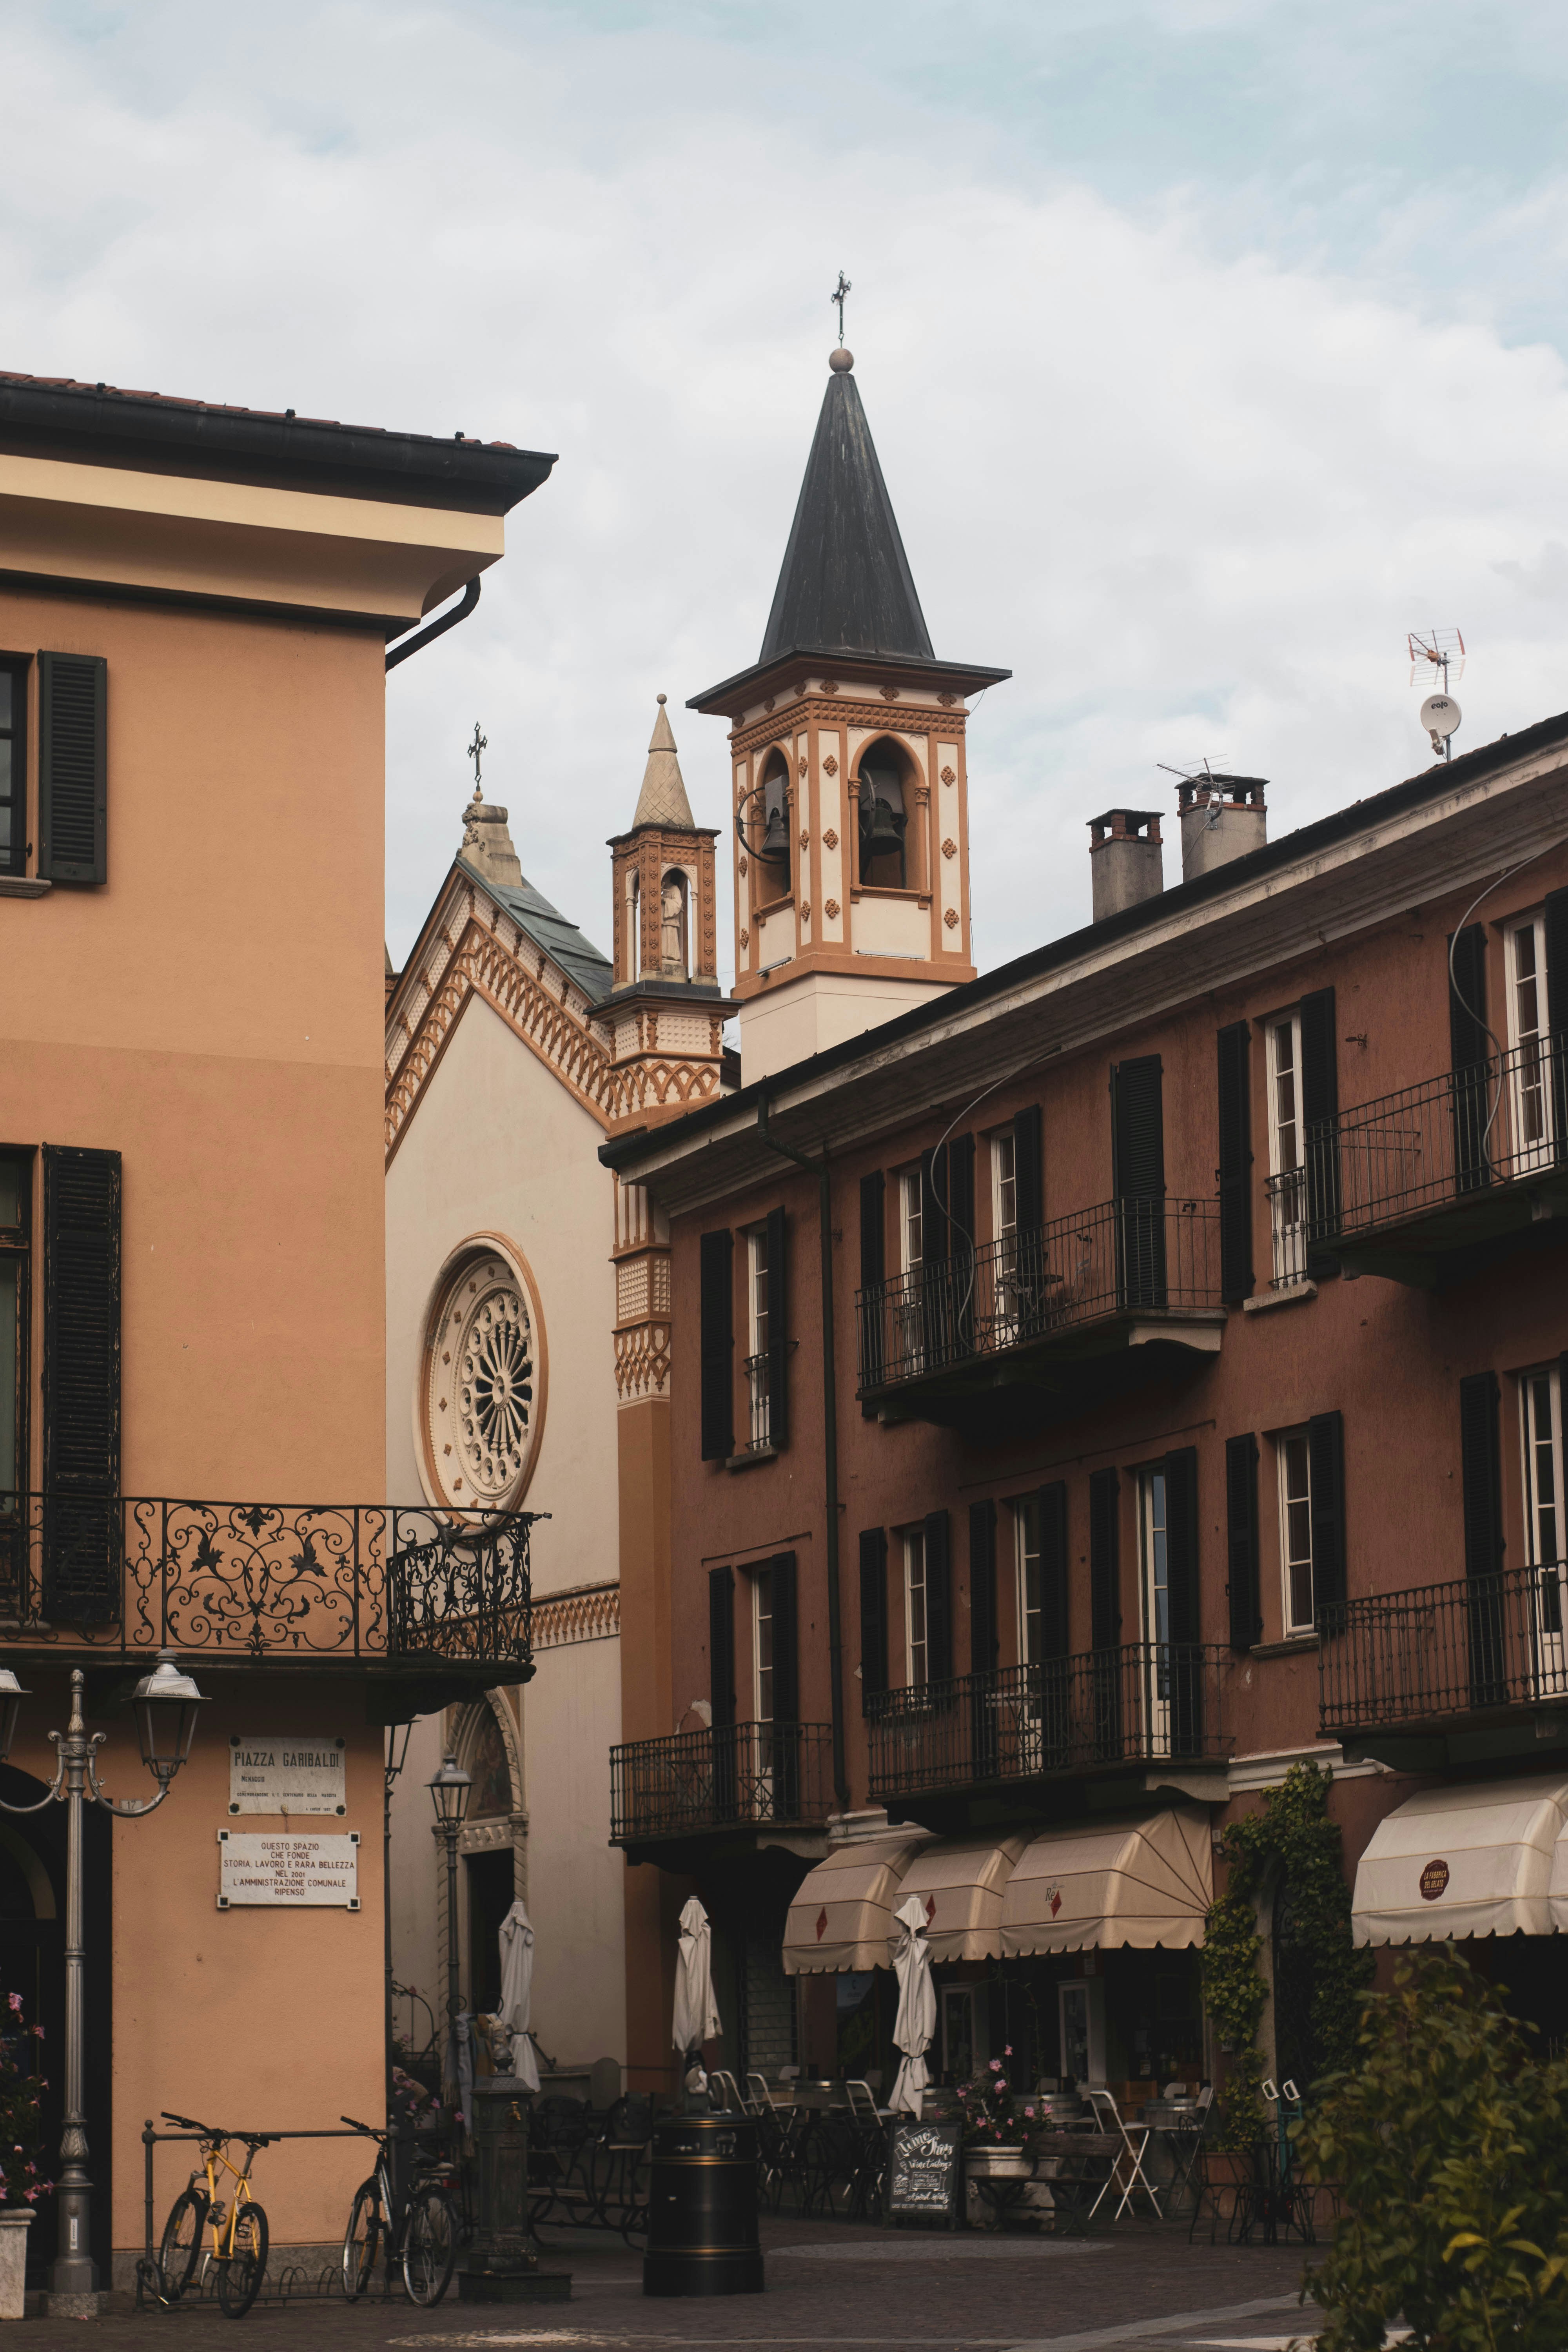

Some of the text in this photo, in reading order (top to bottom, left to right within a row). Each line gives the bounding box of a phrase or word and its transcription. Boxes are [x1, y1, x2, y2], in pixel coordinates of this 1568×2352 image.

[234, 1752, 339, 1767] PIAZZA GARIBALDI
[1429, 1870, 1446, 1879] FABBRICA
[1431, 1880, 1444, 1888] GELATO
[898, 2132, 931, 2153] Wine
[908, 2159, 926, 2169] Wine
